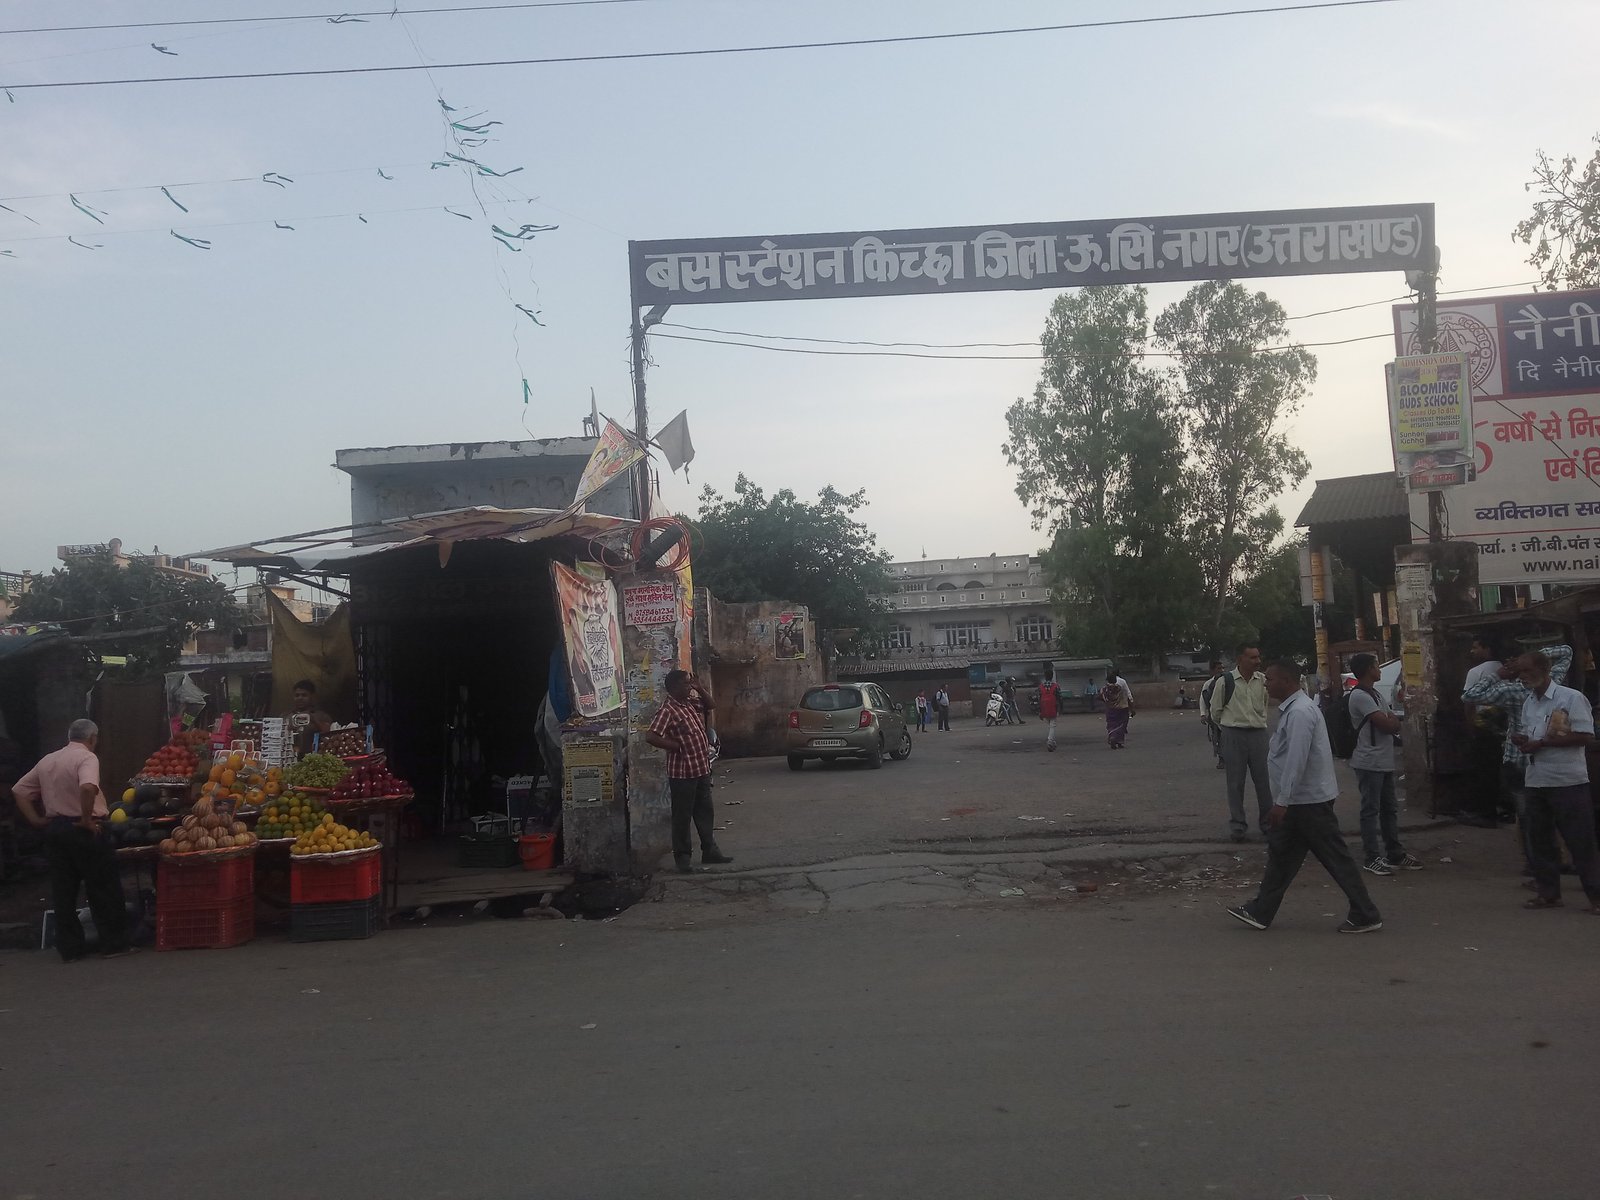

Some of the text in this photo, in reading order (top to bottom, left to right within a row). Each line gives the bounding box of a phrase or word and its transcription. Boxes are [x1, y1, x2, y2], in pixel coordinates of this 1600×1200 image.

[645, 250, 721, 292] बस
[724, 239, 845, 290] स्टेशन
[850, 236, 967, 285] किच्छा
[1440, 355, 1459, 363] OPEN
[1516, 359, 1541, 381] दि
[1401, 381, 1458, 396] BLOOMING
[1400, 394, 1460, 409] BUDS SCHOOL
[1540, 410, 1563, 440] से
[1543, 449, 1580, 481] एवं
[1474, 500, 1570, 521] व्यक्तिगत
[1523, 555, 1600, 572] www.nai
